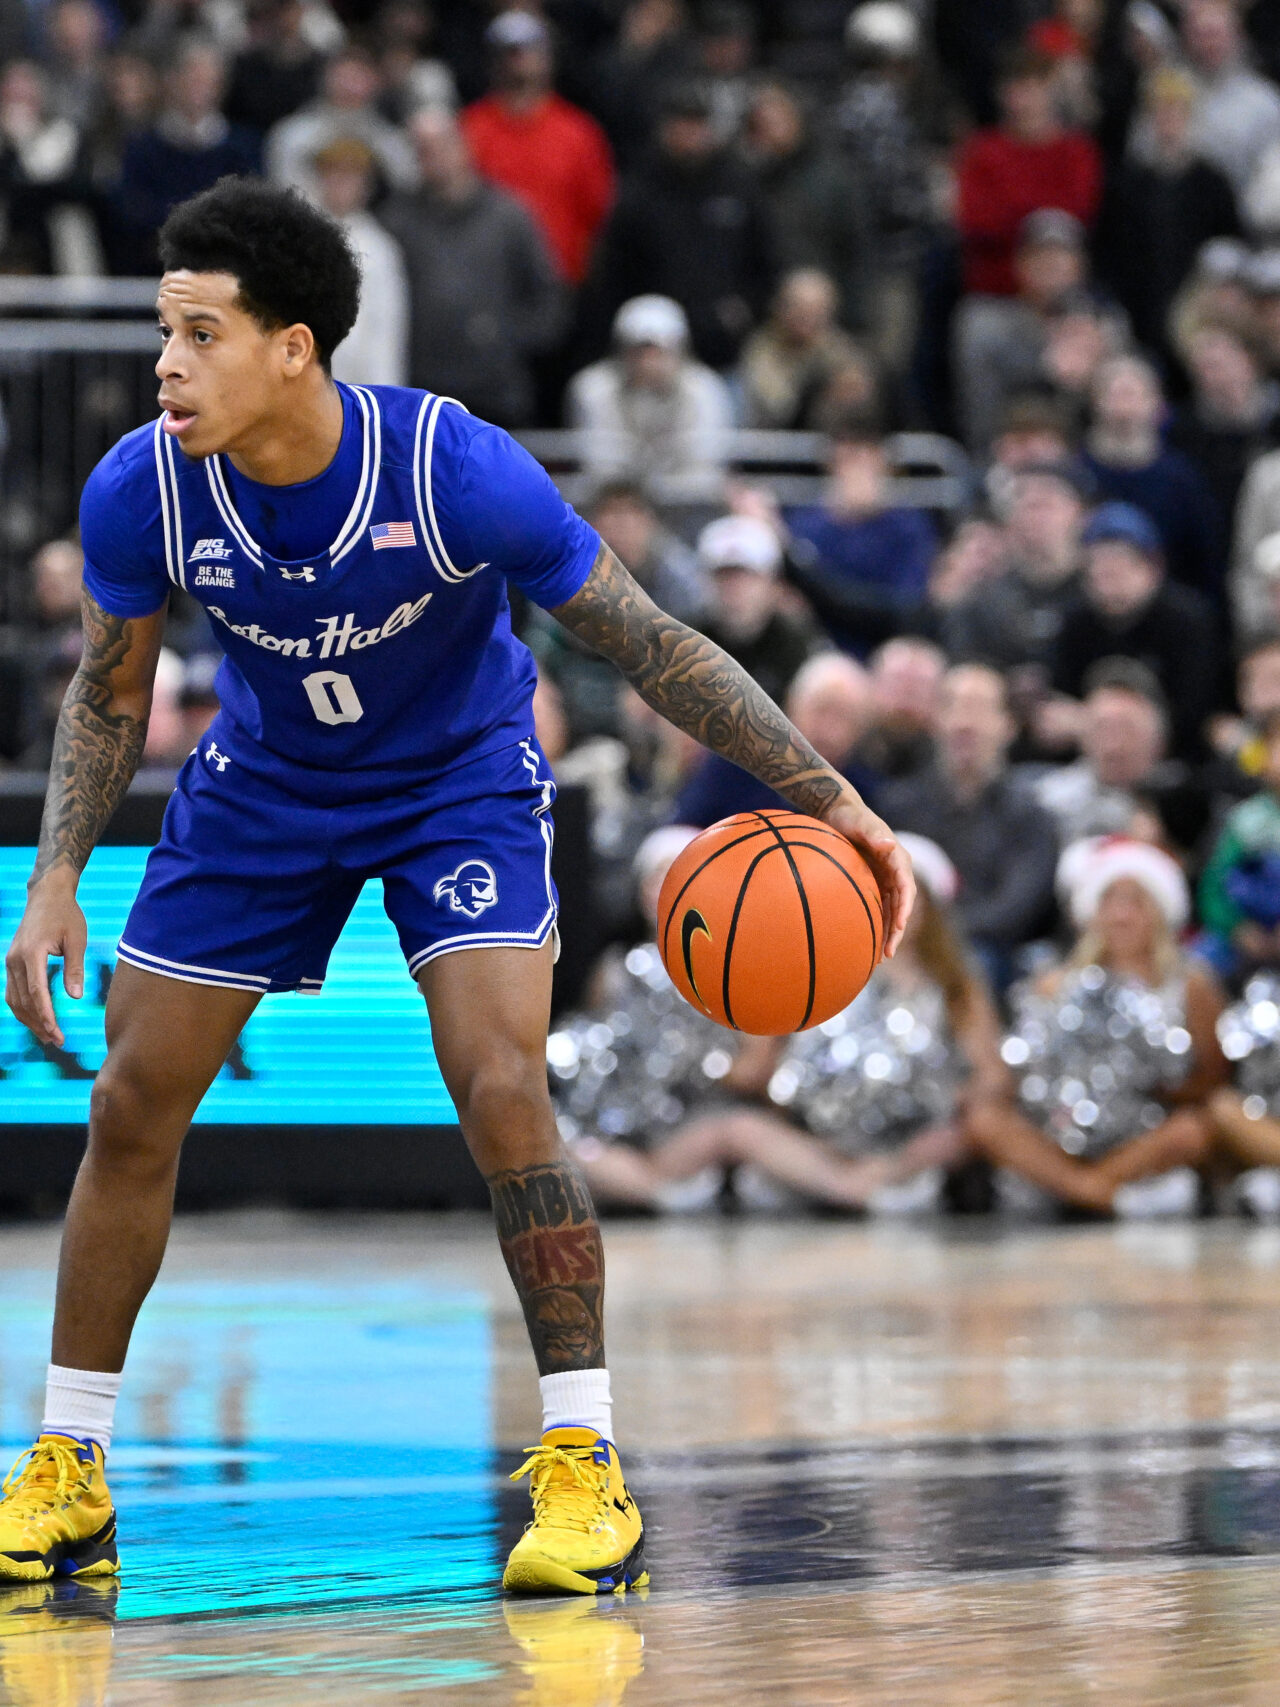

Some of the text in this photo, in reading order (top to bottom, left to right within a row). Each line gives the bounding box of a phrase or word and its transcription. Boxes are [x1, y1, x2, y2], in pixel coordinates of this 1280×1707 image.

[195, 539, 225, 549] BIG
[190, 548, 233, 558] EAST
[198, 566, 233, 579] BE THE
[194, 575, 236, 589] CHANGE
[315, 592, 433, 660] Hall
[302, 670, 364, 726] 0
